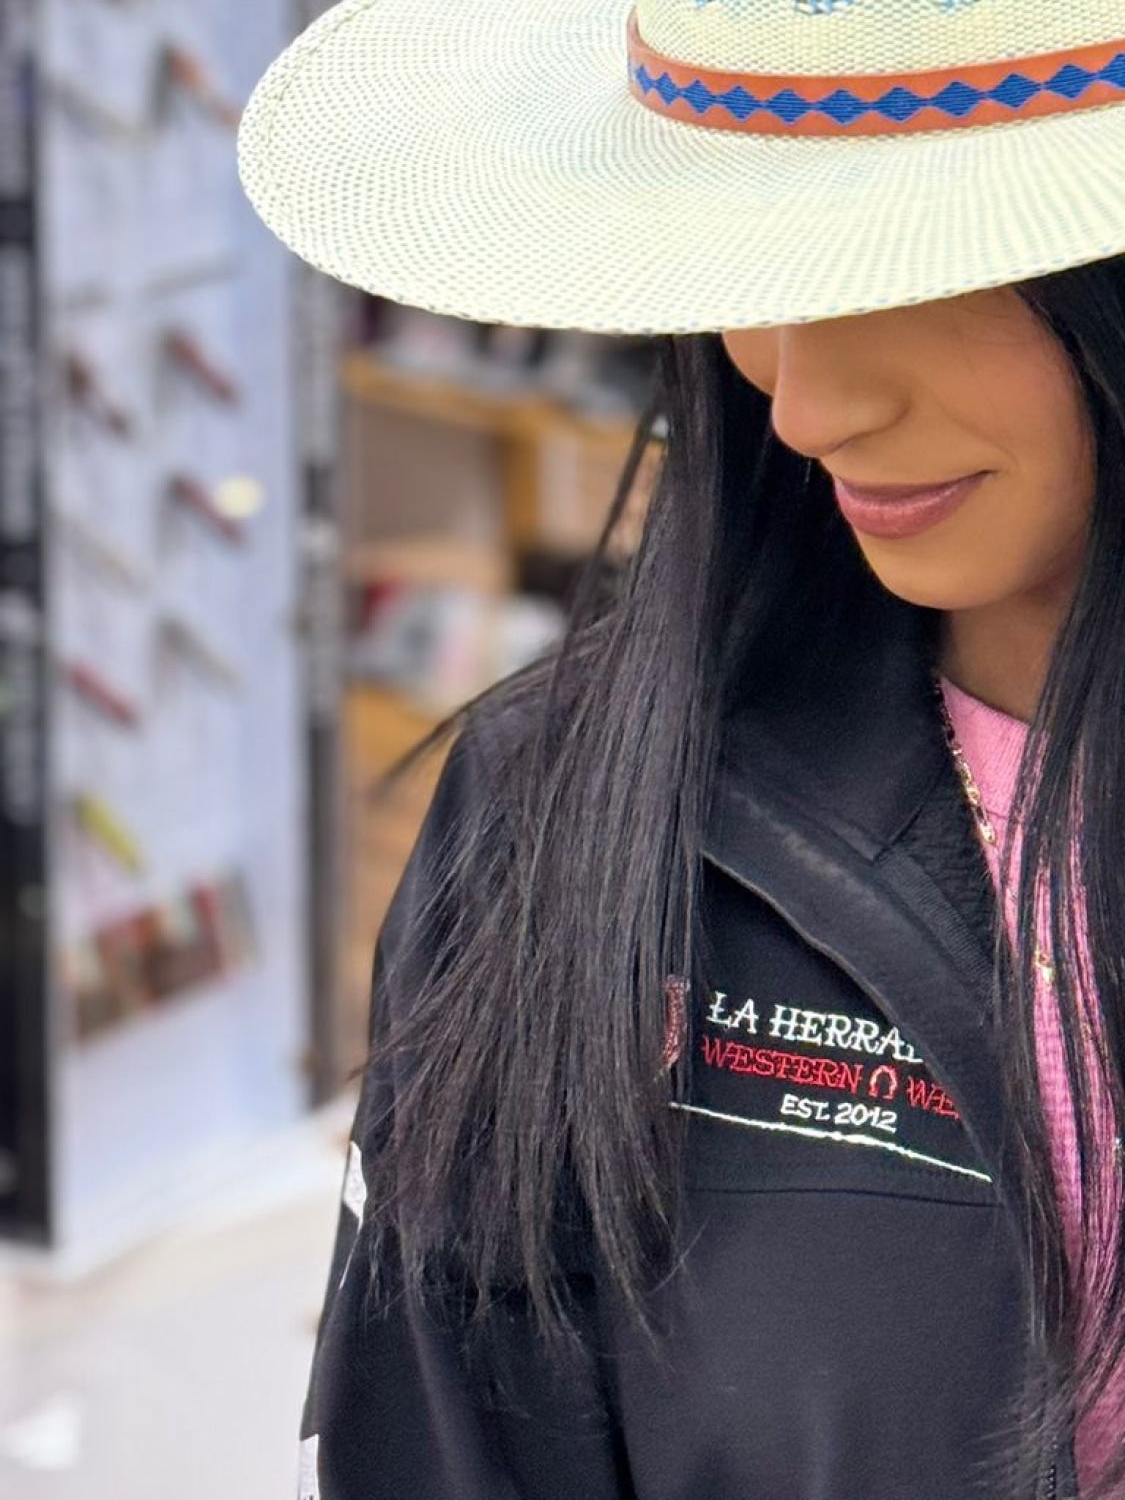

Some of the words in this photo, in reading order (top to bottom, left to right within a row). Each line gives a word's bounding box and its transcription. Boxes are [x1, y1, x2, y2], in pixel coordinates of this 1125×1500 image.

[706, 991, 760, 1034] LA
[701, 1036, 864, 1094] WESTERN
[906, 1075, 961, 1120] WE
[780, 1093, 830, 1122] EST.
[834, 1102, 898, 1134] 2012
